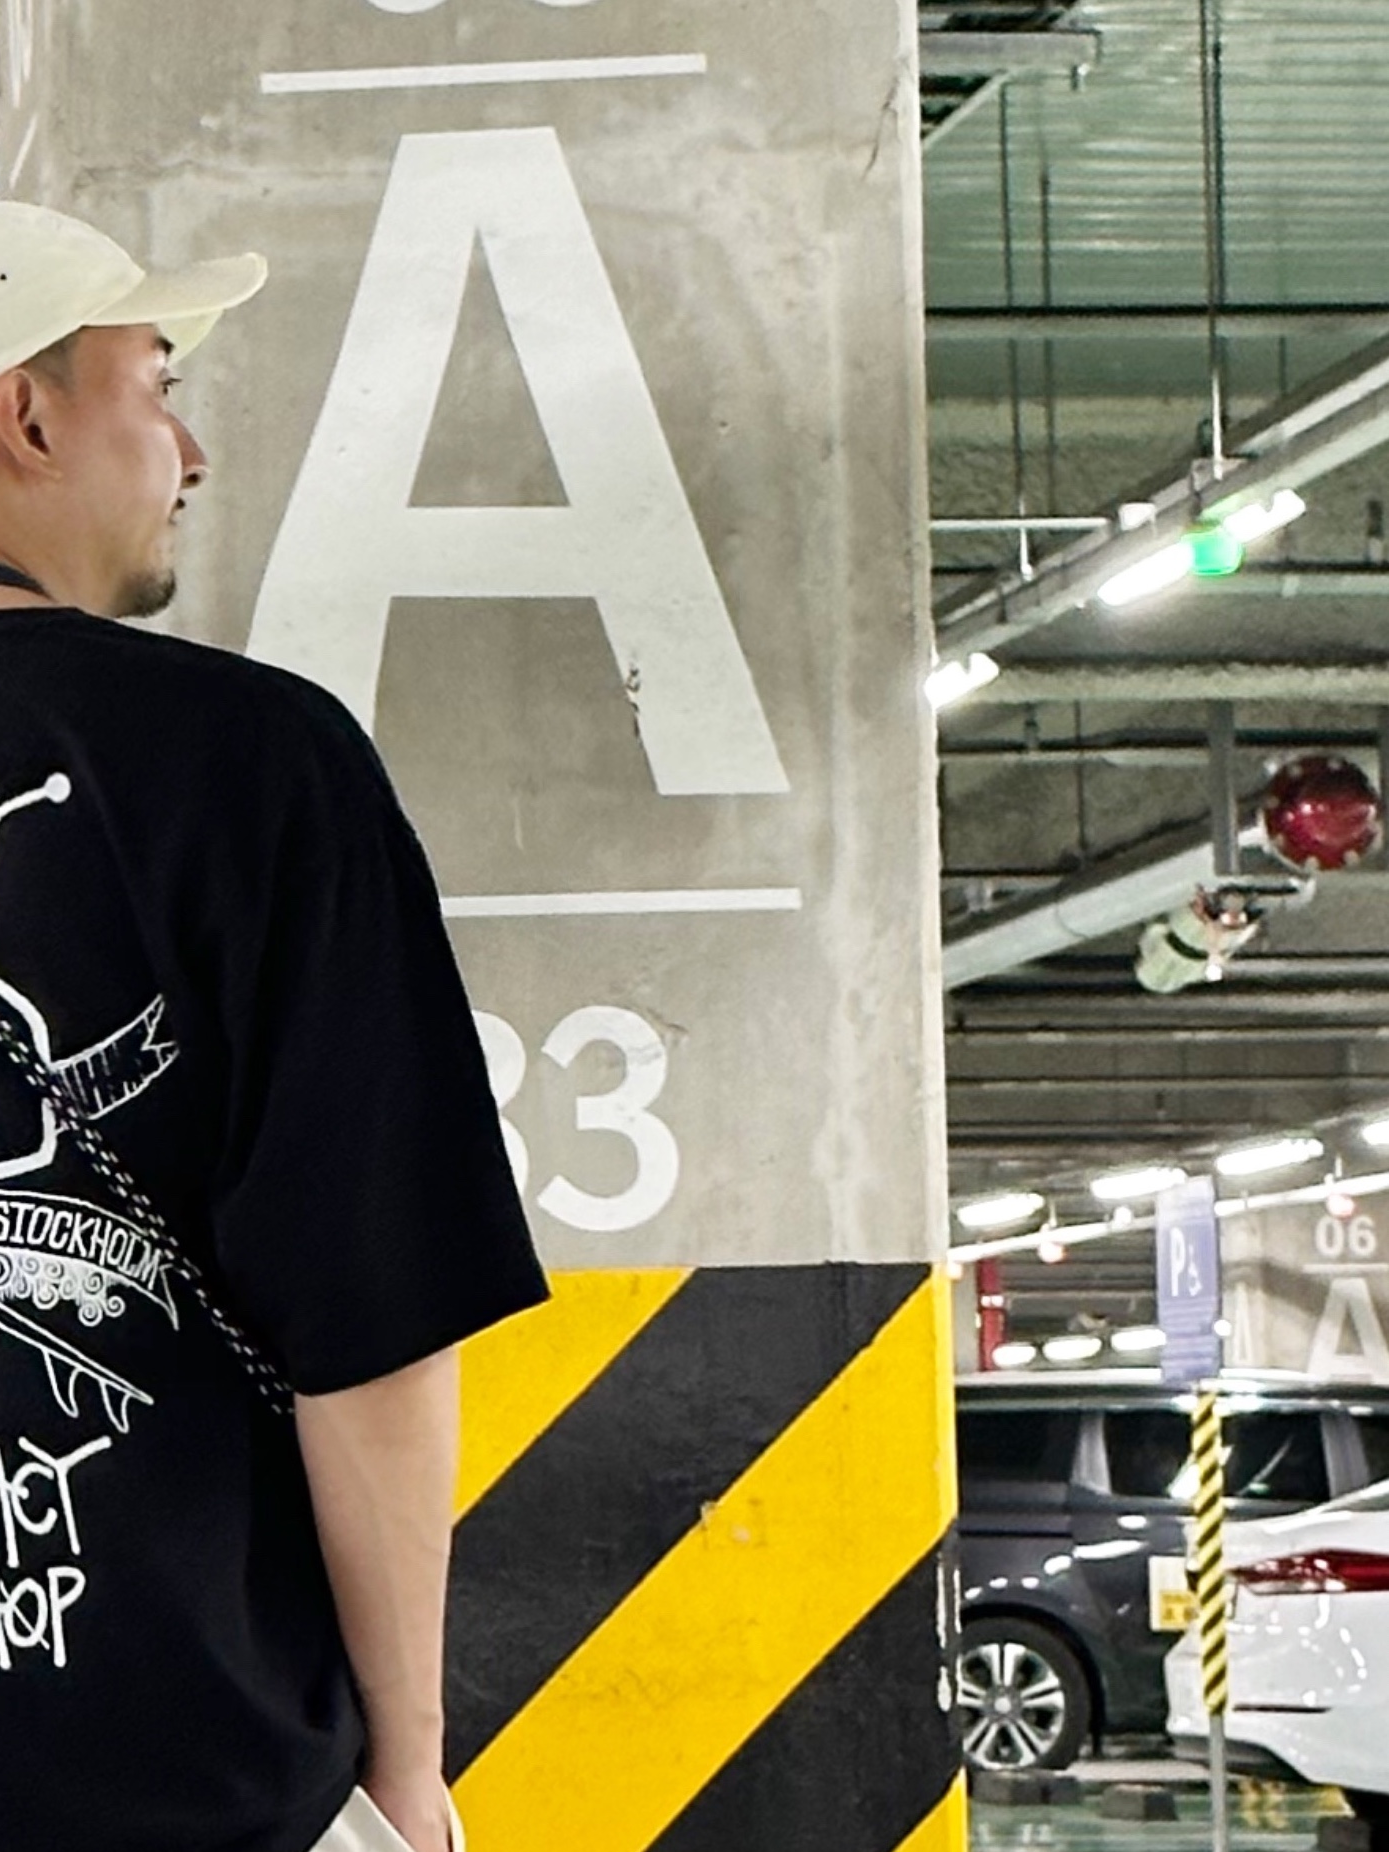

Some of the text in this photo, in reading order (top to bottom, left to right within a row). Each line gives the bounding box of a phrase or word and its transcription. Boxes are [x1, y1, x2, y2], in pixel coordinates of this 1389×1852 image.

[246, 127, 791, 796] A
[1315, 1215, 1377, 1259] 06
[1307, 1277, 1389, 1385] A
